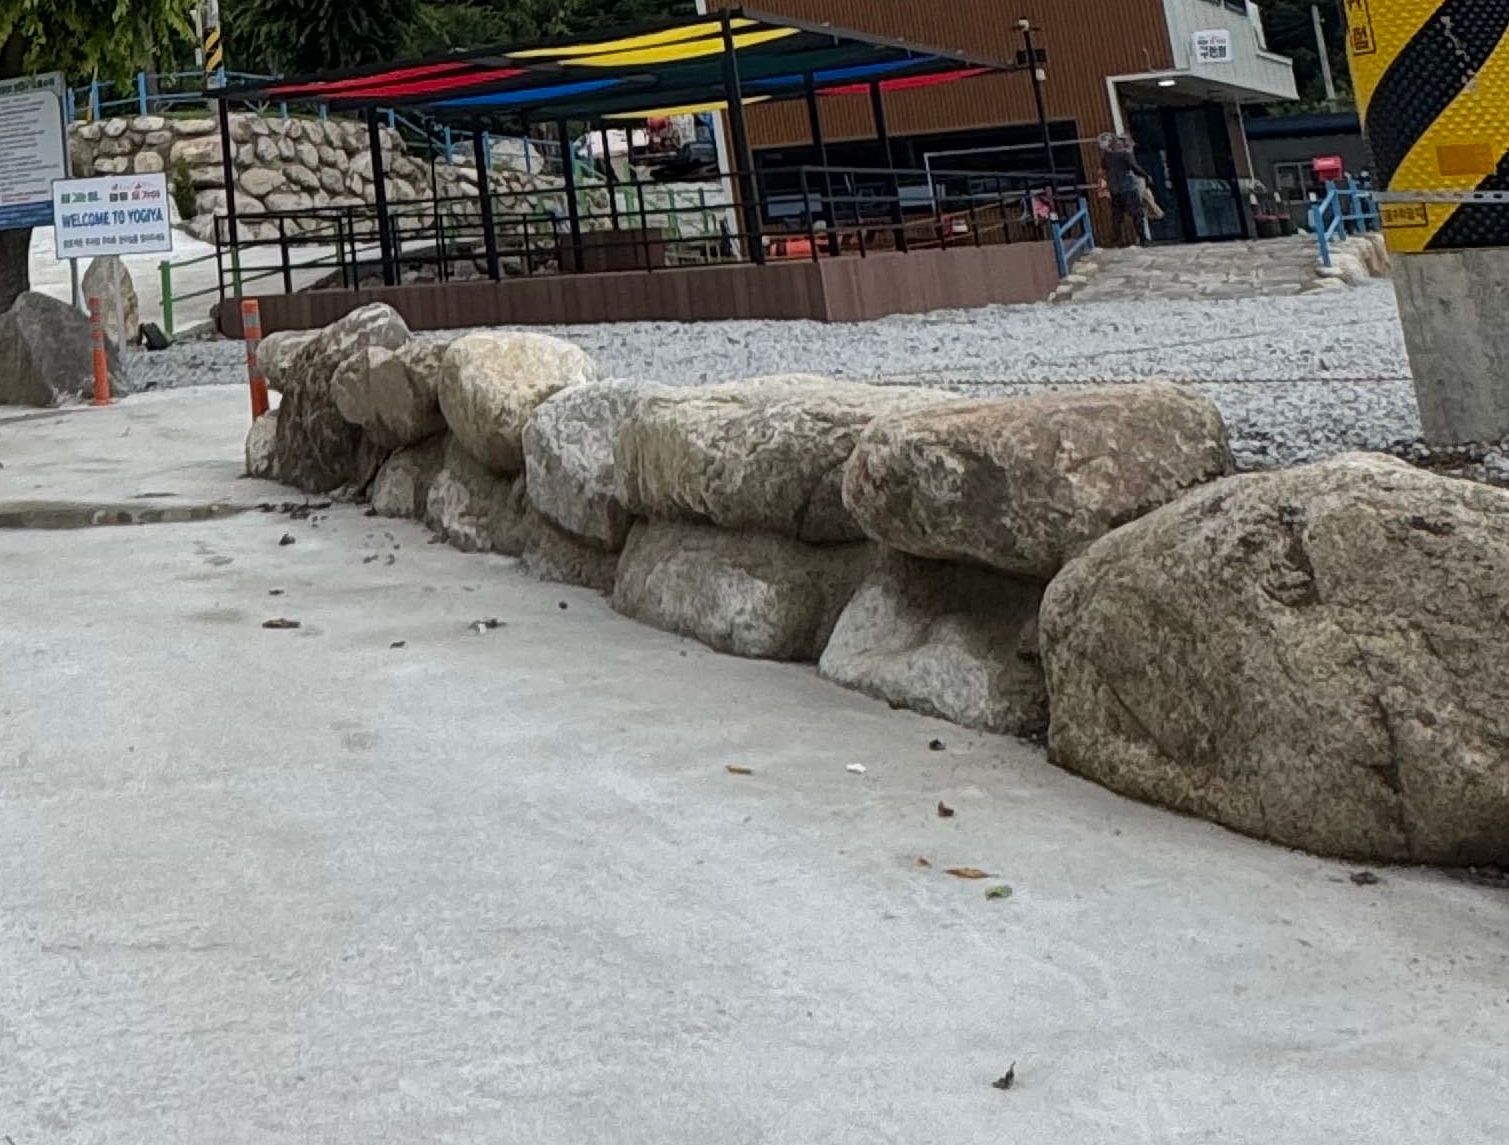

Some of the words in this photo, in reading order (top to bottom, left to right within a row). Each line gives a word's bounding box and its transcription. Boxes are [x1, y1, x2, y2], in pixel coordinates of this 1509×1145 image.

[62, 211, 110, 228] WELCOME
[112, 209, 125, 225] TO
[127, 207, 163, 224] YOGIYA
